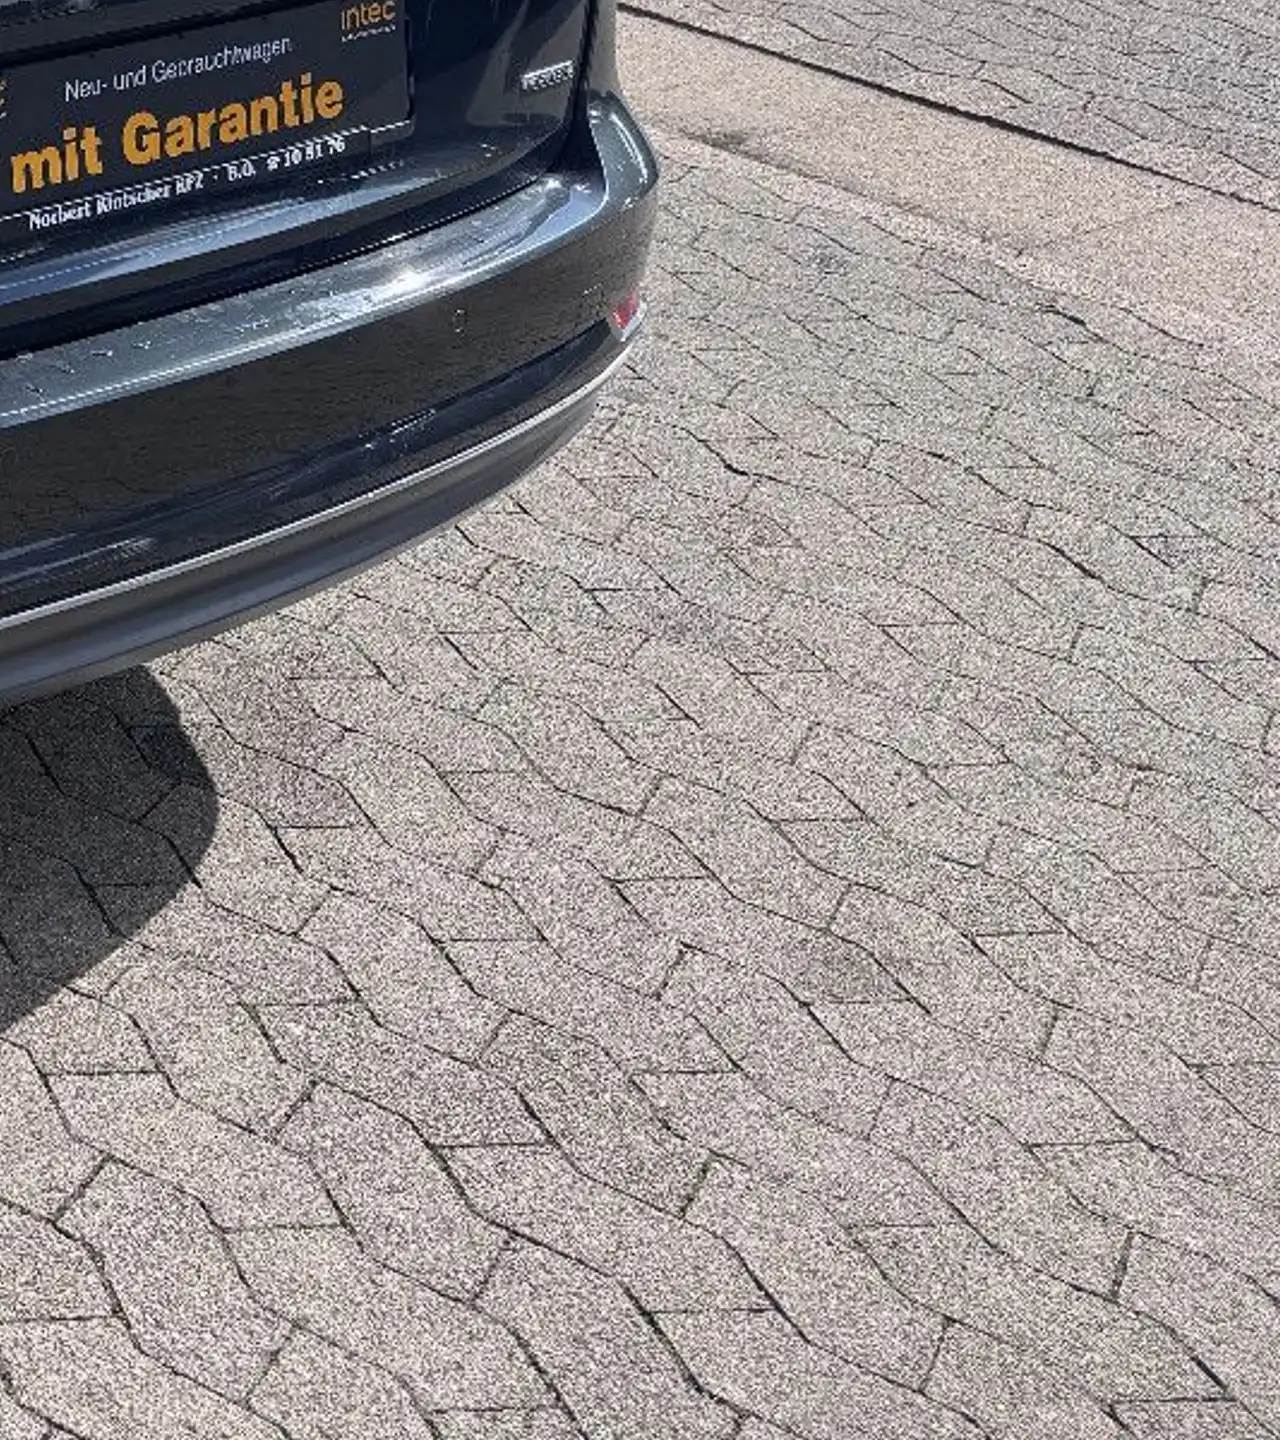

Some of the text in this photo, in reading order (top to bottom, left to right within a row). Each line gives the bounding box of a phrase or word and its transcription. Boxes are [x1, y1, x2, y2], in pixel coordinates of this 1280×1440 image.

[65, 38, 293, 102] Neu- und Gebrauchtwagen
[10, 72, 344, 194] mit Garantie
